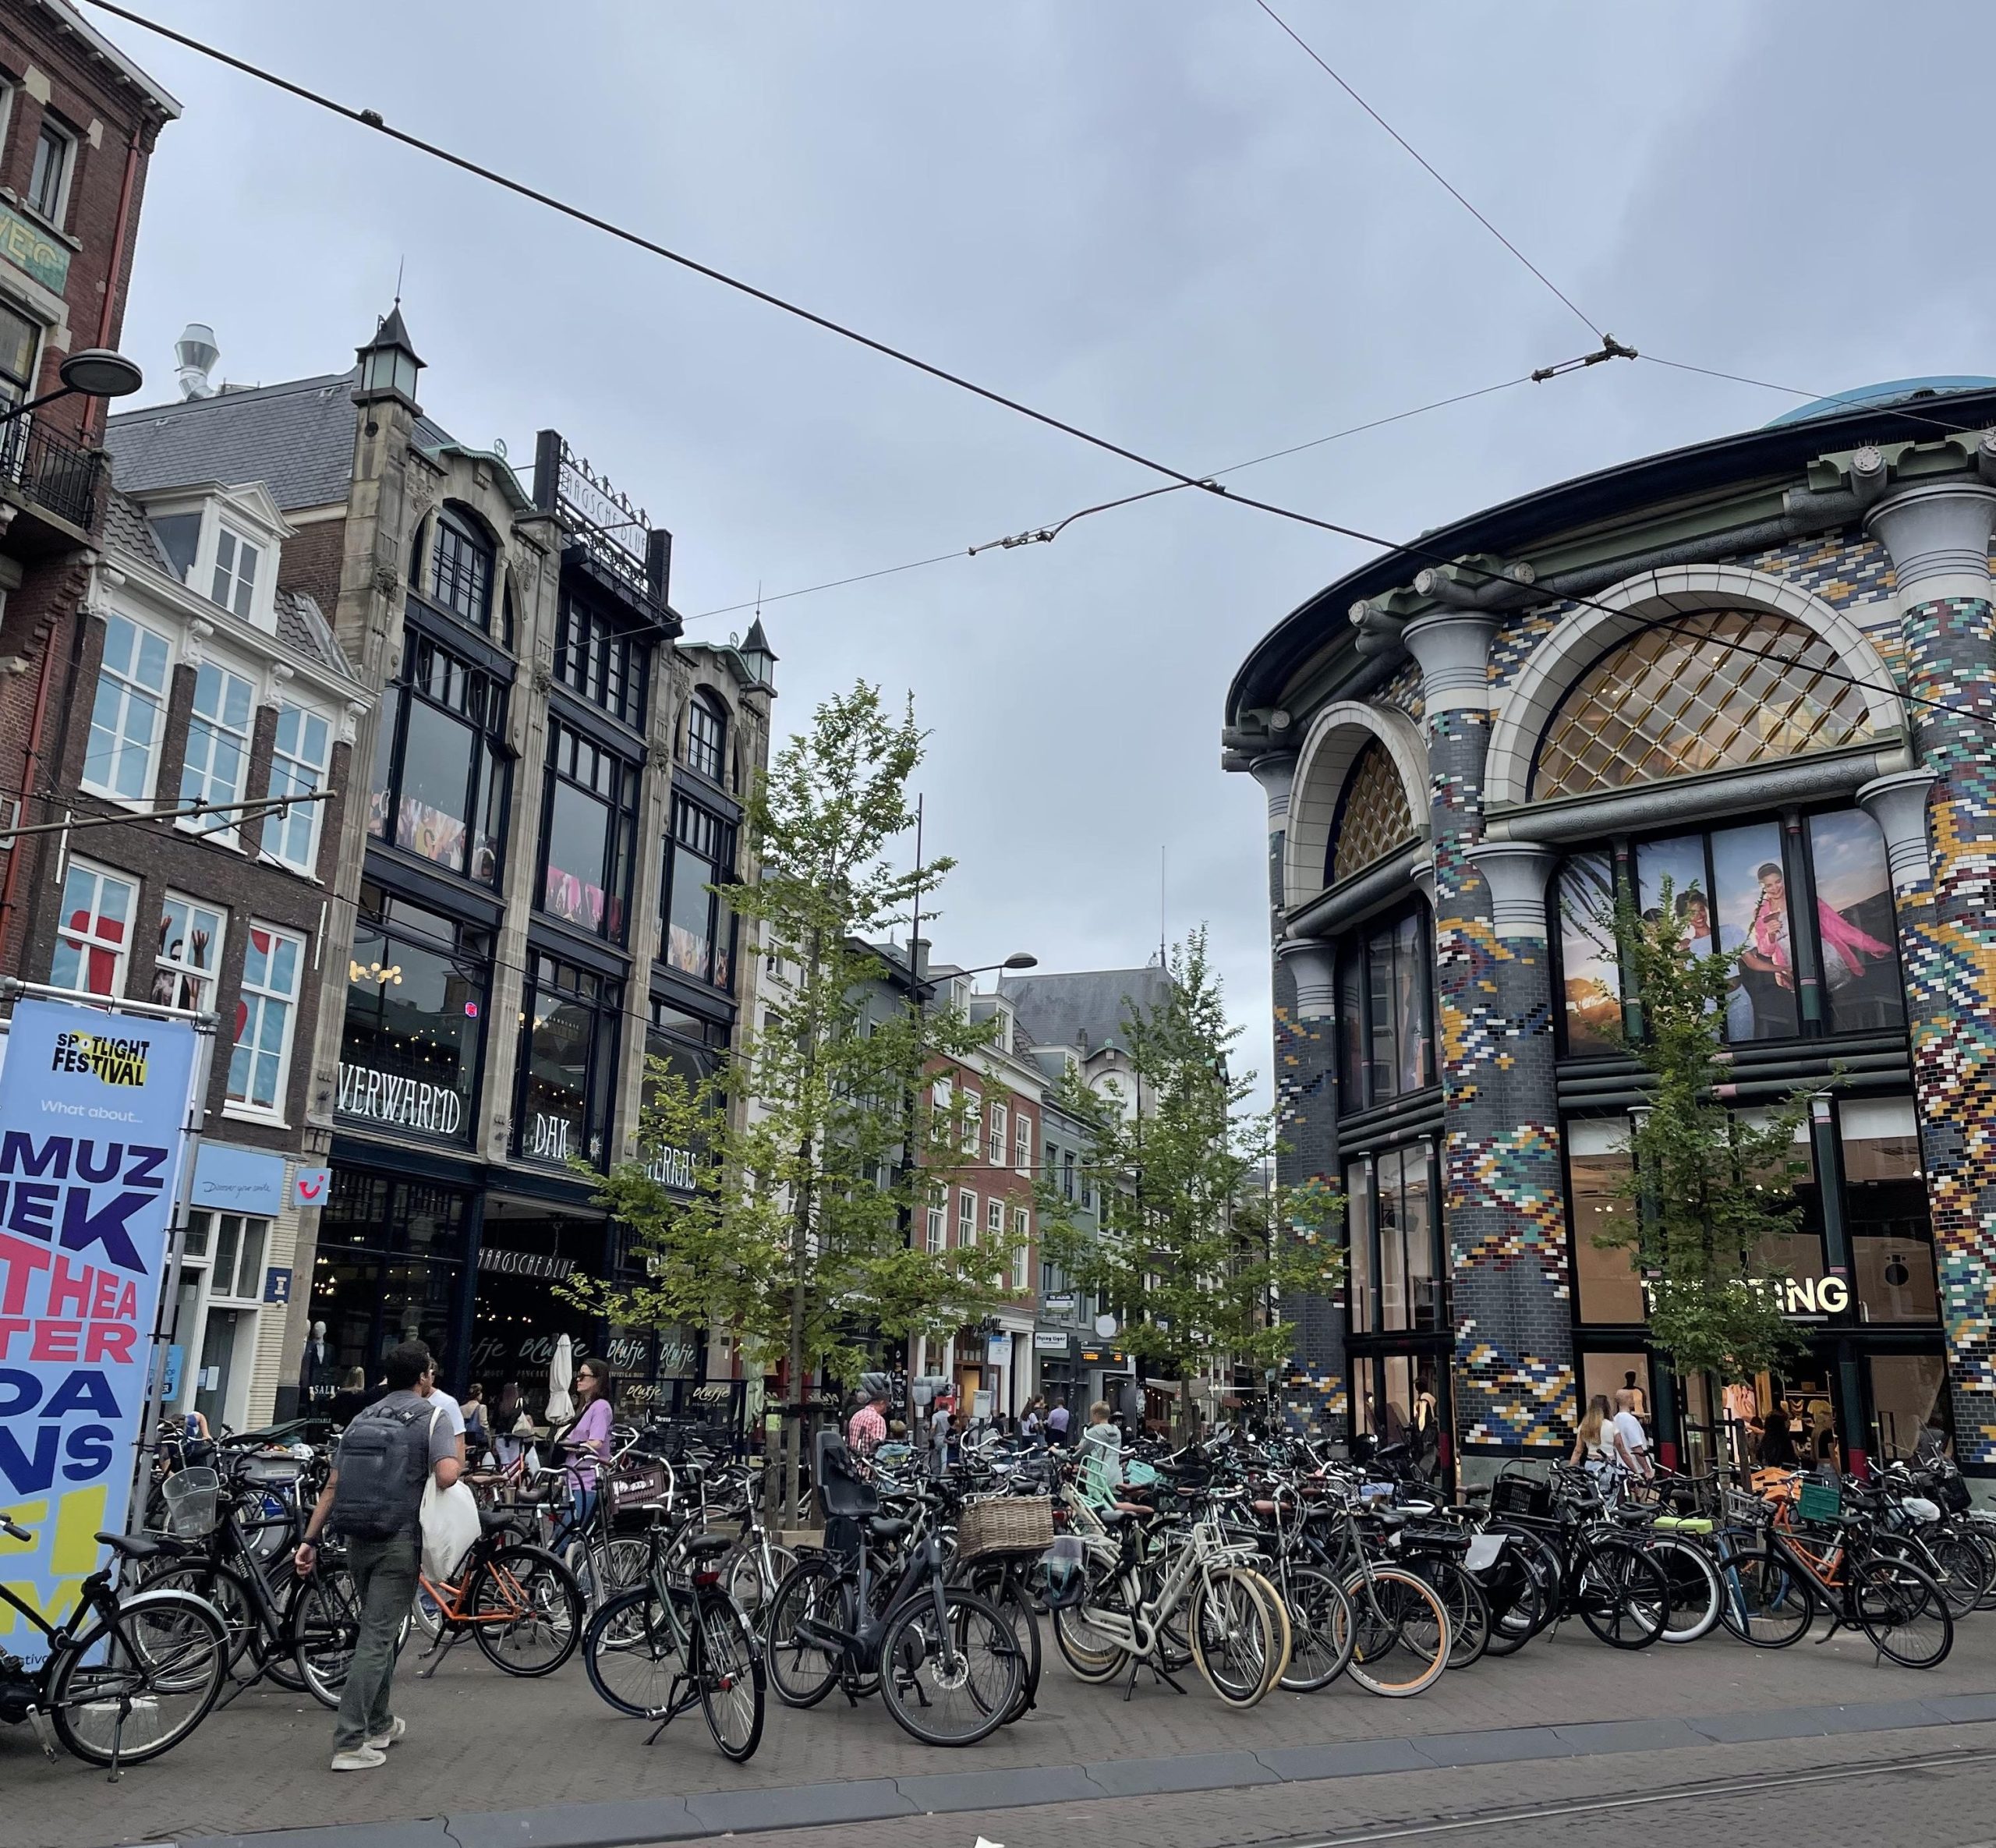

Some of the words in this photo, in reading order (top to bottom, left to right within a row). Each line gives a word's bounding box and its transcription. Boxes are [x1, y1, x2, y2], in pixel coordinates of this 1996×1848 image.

[52, 1047, 146, 1086] FESTIVAL
[57, 1033, 150, 1064] SPOTLIGHT
[41, 1099, 85, 1116] What
[337, 1061, 461, 1134] VERWARMD
[0, 1131, 168, 1189] MUZ
[533, 1112, 571, 1160] DAK
[0, 1233, 136, 1320] THEA
[0, 1368, 122, 1418] DA
[0, 1425, 115, 1495] NS
[235, 1554, 250, 1579] UNION
